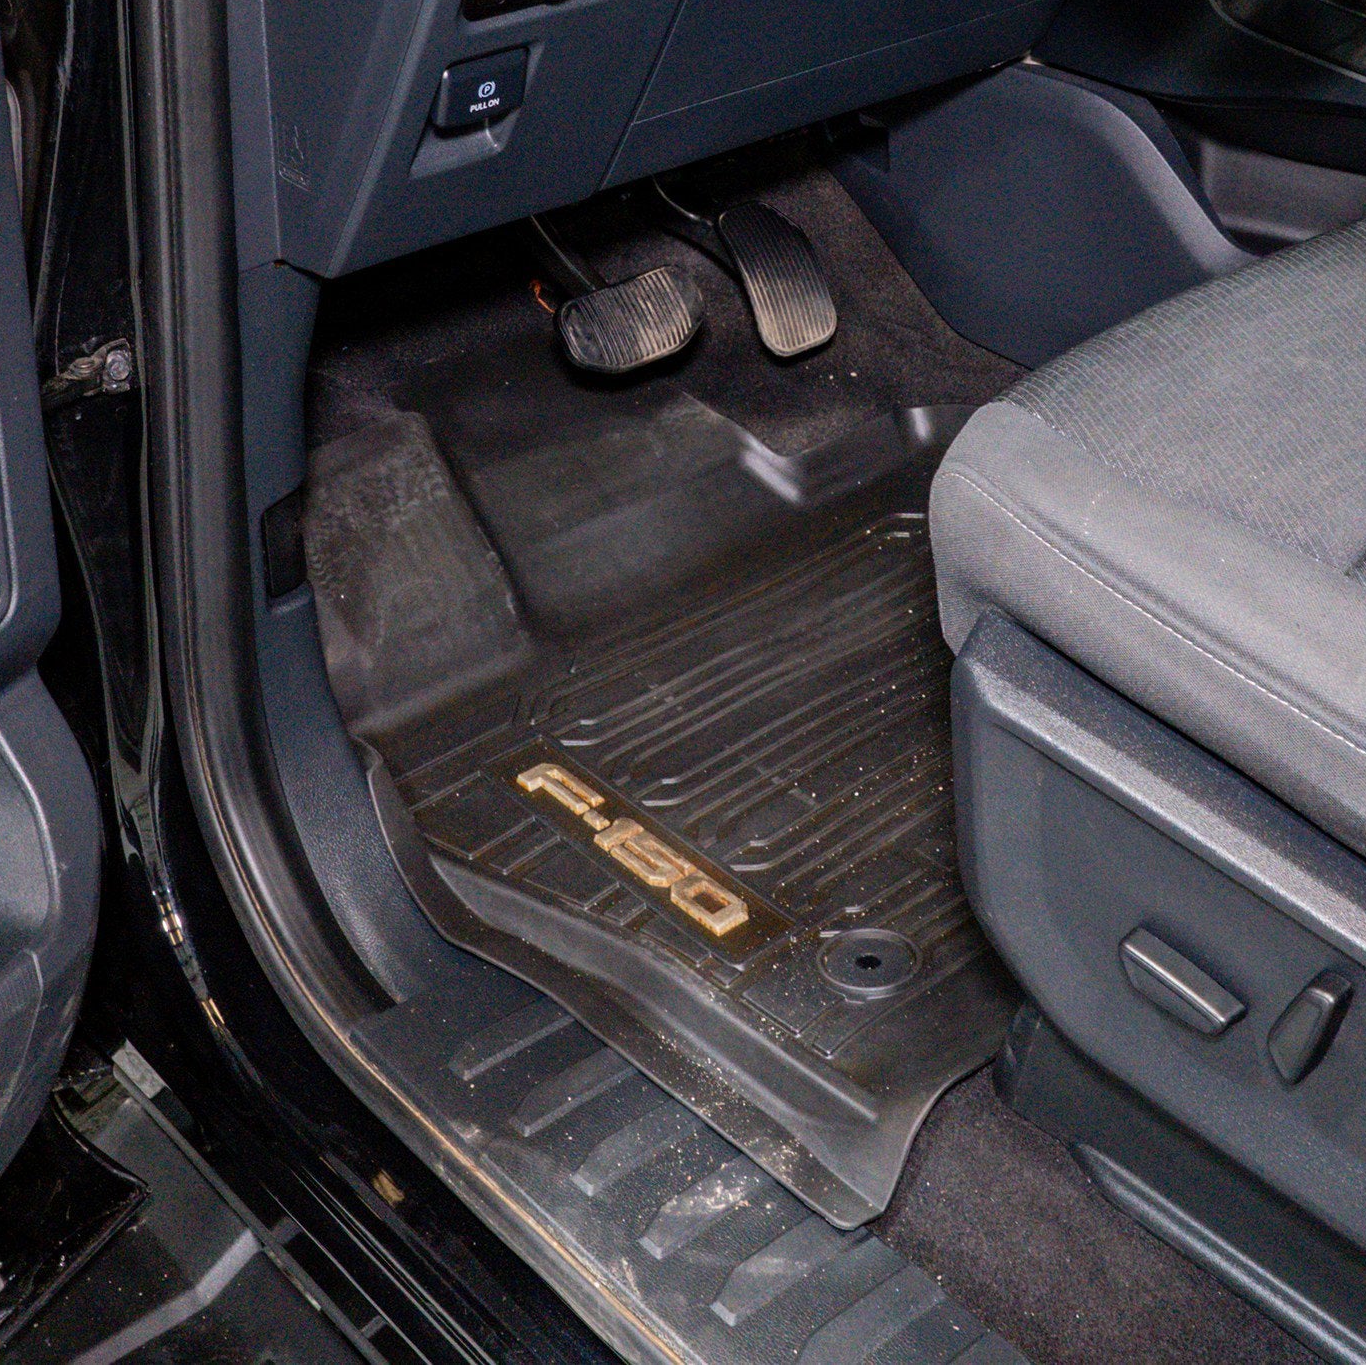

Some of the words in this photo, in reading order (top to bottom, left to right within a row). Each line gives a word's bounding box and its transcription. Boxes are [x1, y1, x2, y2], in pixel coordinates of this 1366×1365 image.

[470, 102, 487, 113] PULL
[488, 98, 500, 107] ON
[517, 763, 749, 936] F-150
